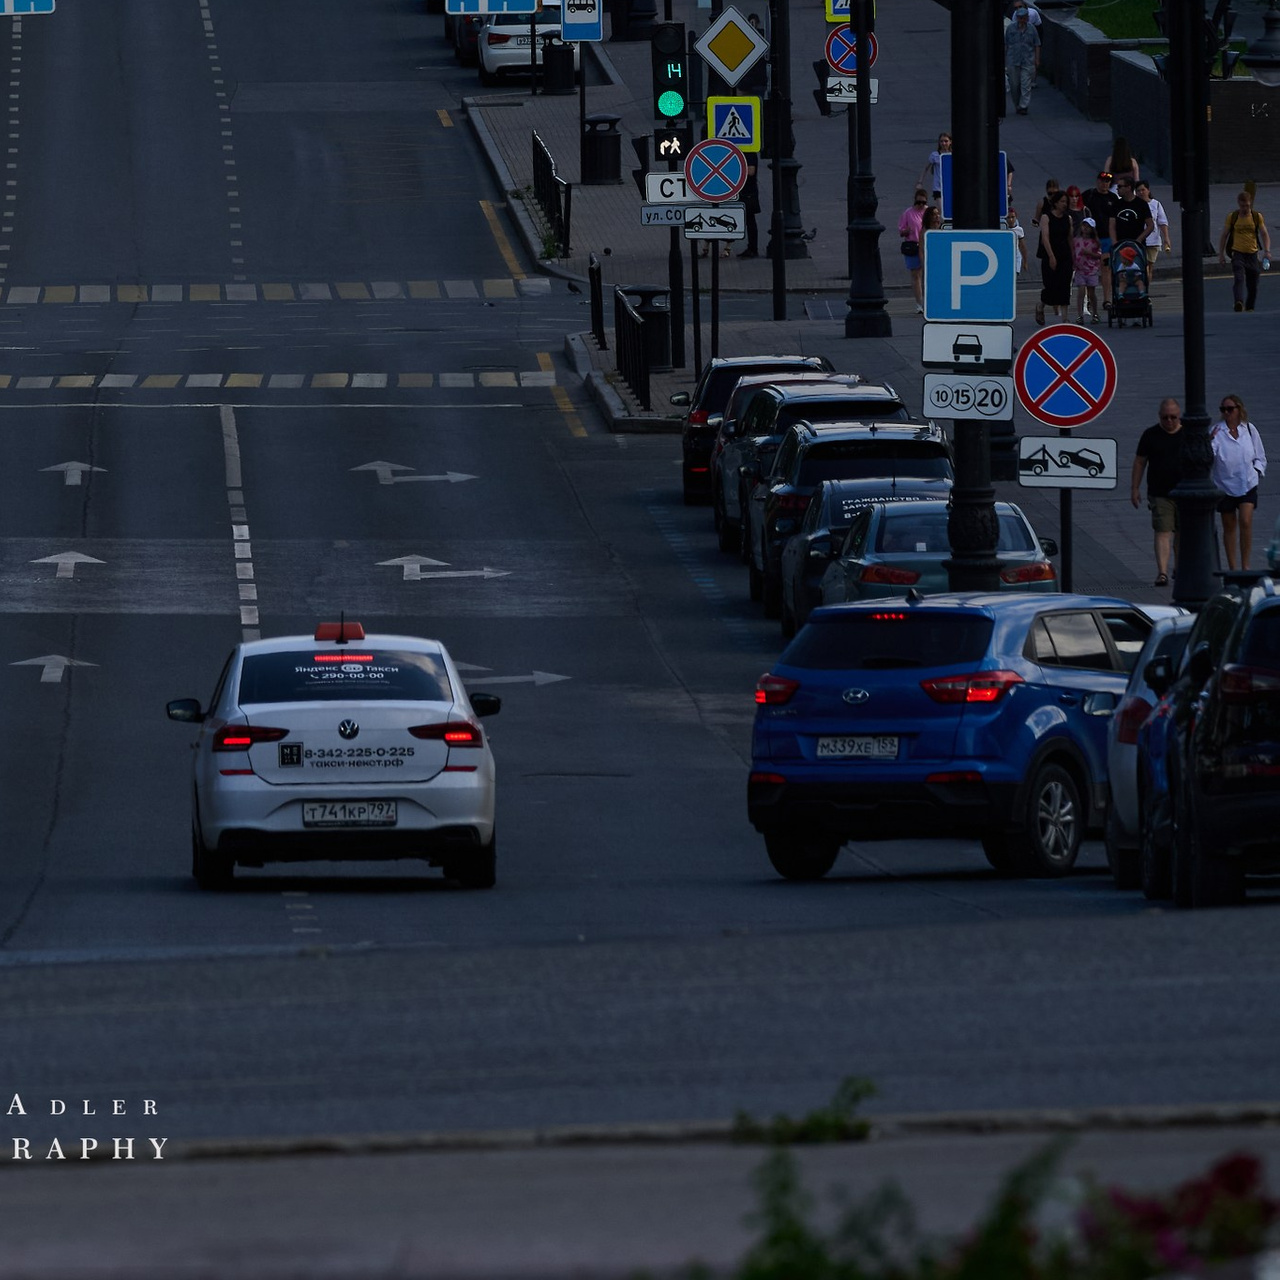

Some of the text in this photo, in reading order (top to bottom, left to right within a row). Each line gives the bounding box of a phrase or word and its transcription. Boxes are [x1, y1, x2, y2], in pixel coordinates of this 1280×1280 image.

[667, 63, 682, 79] 14
[645, 211, 662, 224] ул.
[951, 241, 999, 310] P
[935, 389, 1003, 407] 10 15 20
[842, 497, 920, 505] ГРАЖДАНСТВО
[295, 665, 338, 673] Яндекс
[365, 665, 399, 673] Такси
[370, 802, 392, 815] 797
